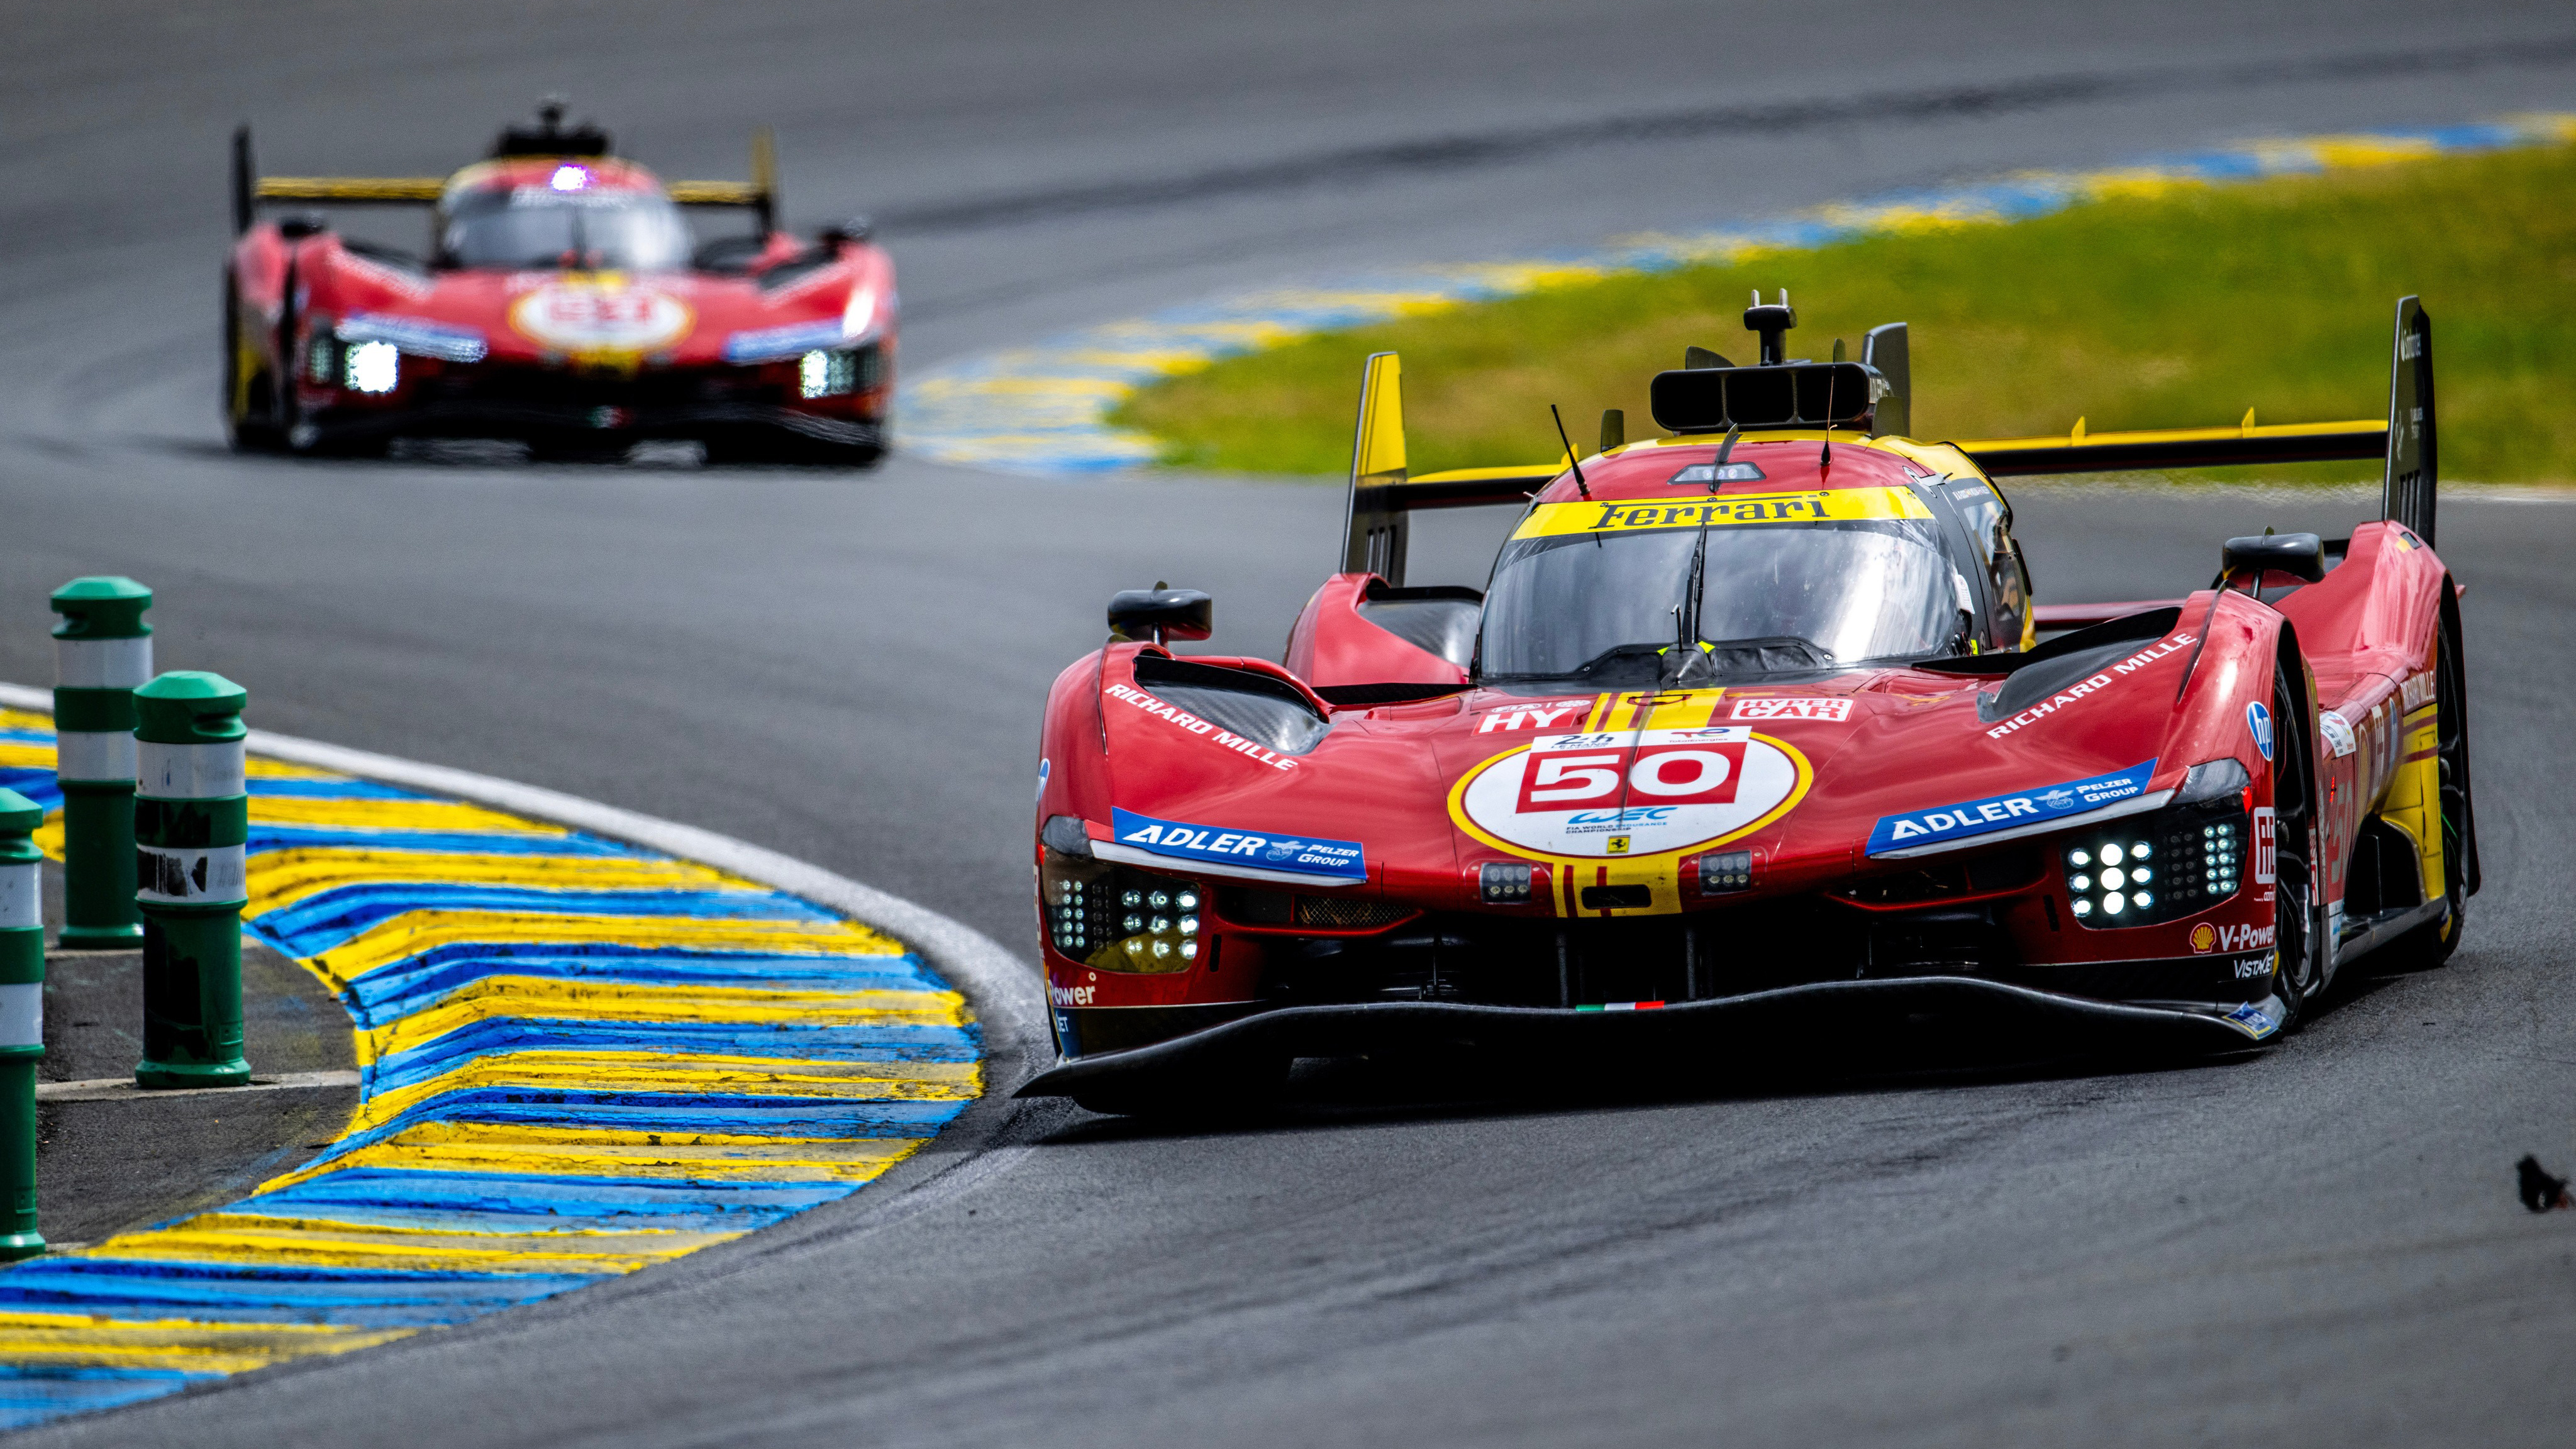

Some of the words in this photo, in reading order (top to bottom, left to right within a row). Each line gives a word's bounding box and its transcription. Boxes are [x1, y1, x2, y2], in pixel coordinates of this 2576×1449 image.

[1587, 494, 1831, 530] Ferrari
[1986, 674, 2112, 739] RICHARD
[2113, 633, 2197, 675] MILLE
[1479, 708, 1573, 733] HY
[1739, 706, 1841, 719] CAR
[1104, 684, 1213, 735] RICHARD
[1212, 731, 1299, 770] MILLE
[2250, 702, 2272, 760] hp
[1530, 750, 1731, 802] 50
[2076, 778, 2133, 794] PELZER
[2084, 786, 2139, 802] GROUP
[1568, 807, 1678, 824] WEC
[1892, 798, 2040, 841] ADLER
[1123, 824, 1267, 856] ADLER
[1306, 844, 1360, 857] PELZER
[1297, 853, 1350, 867] GROUP
[2219, 924, 2275, 952] V-Power
